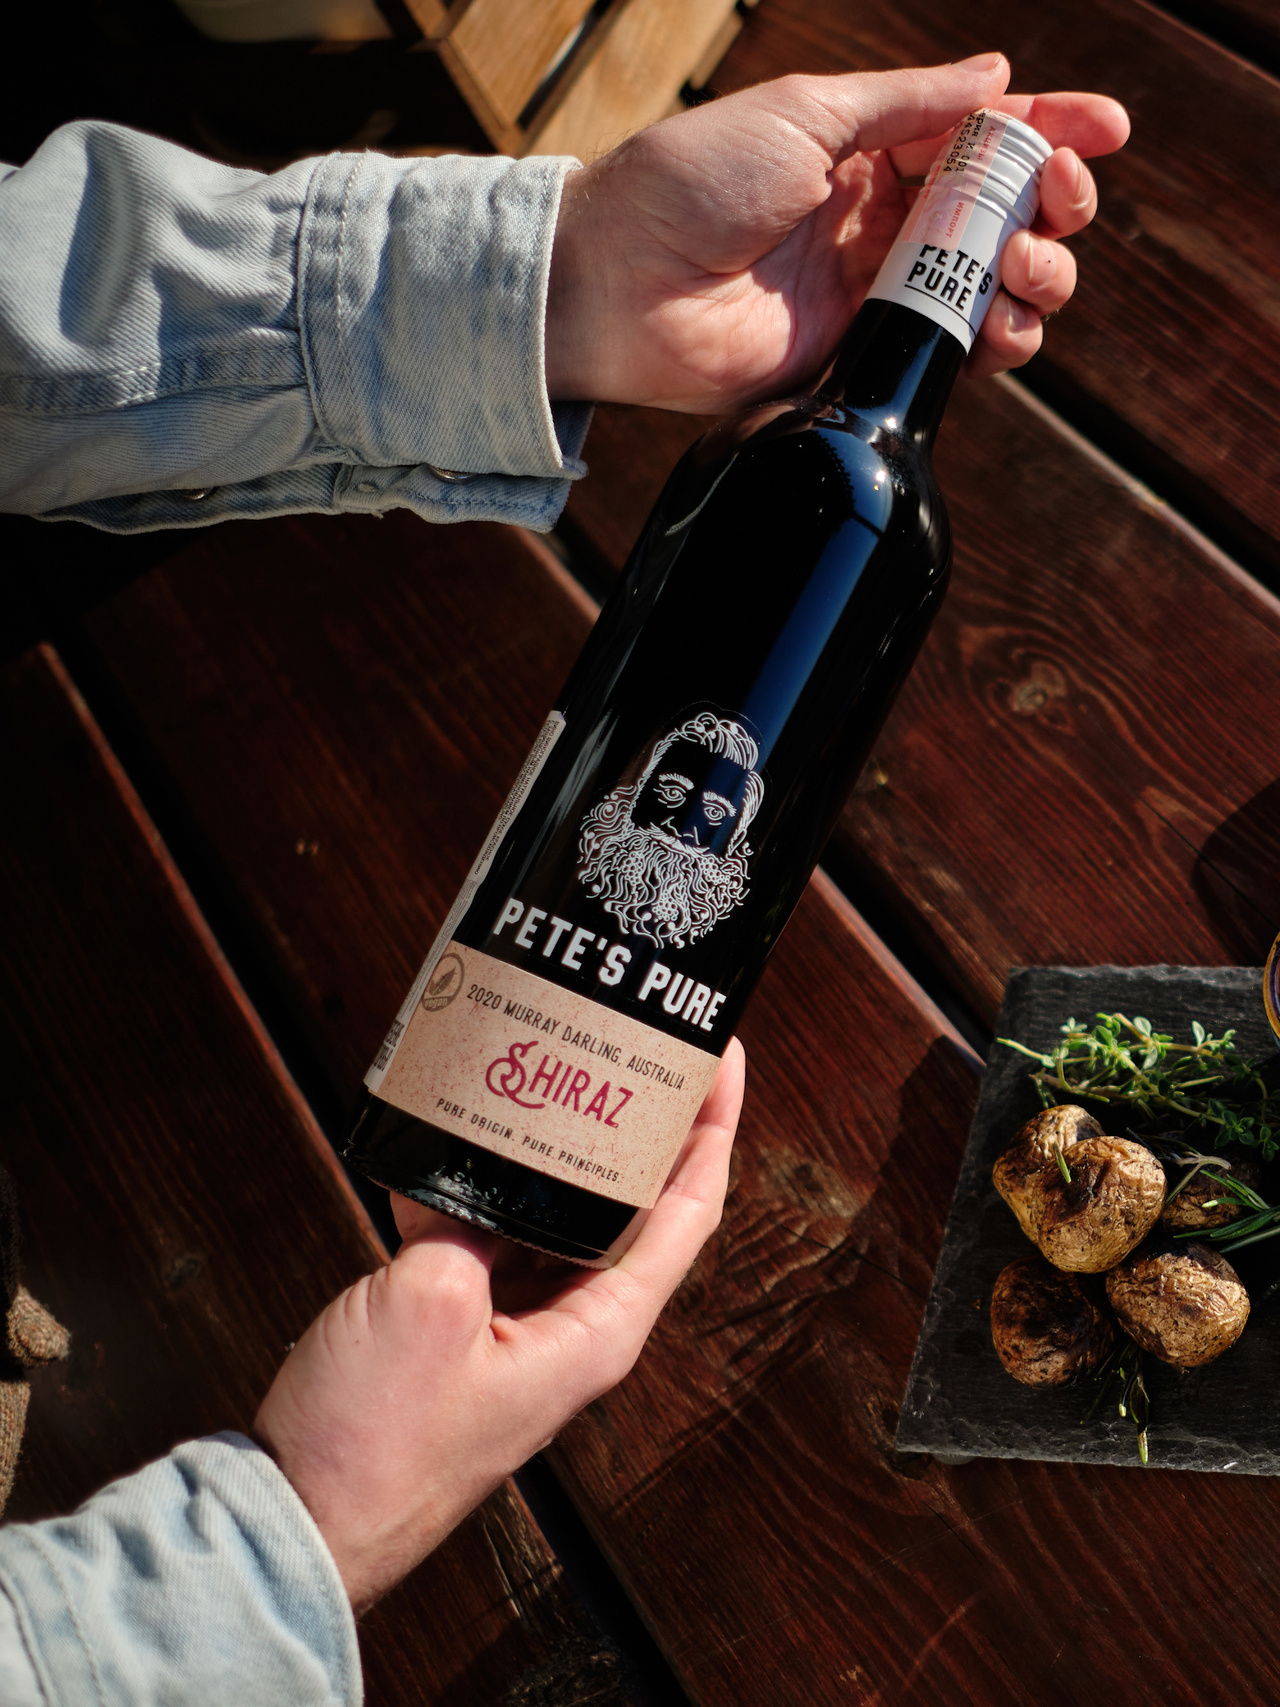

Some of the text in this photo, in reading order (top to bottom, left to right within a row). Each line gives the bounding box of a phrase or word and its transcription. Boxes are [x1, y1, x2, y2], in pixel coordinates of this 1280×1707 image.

[945, 201, 965, 238] ИМПОРТ
[906, 261, 973, 311] PURE
[493, 897, 633, 986] PETE'S
[637, 961, 727, 1032] PURE
[466, 984, 685, 1091] 2020 MURRAY DARLING, AUSTRALIA
[485, 1040, 634, 1129] SHIRAZ
[436, 1098, 620, 1184] PURE ORIGIN. PURE PRINCIPLES.
